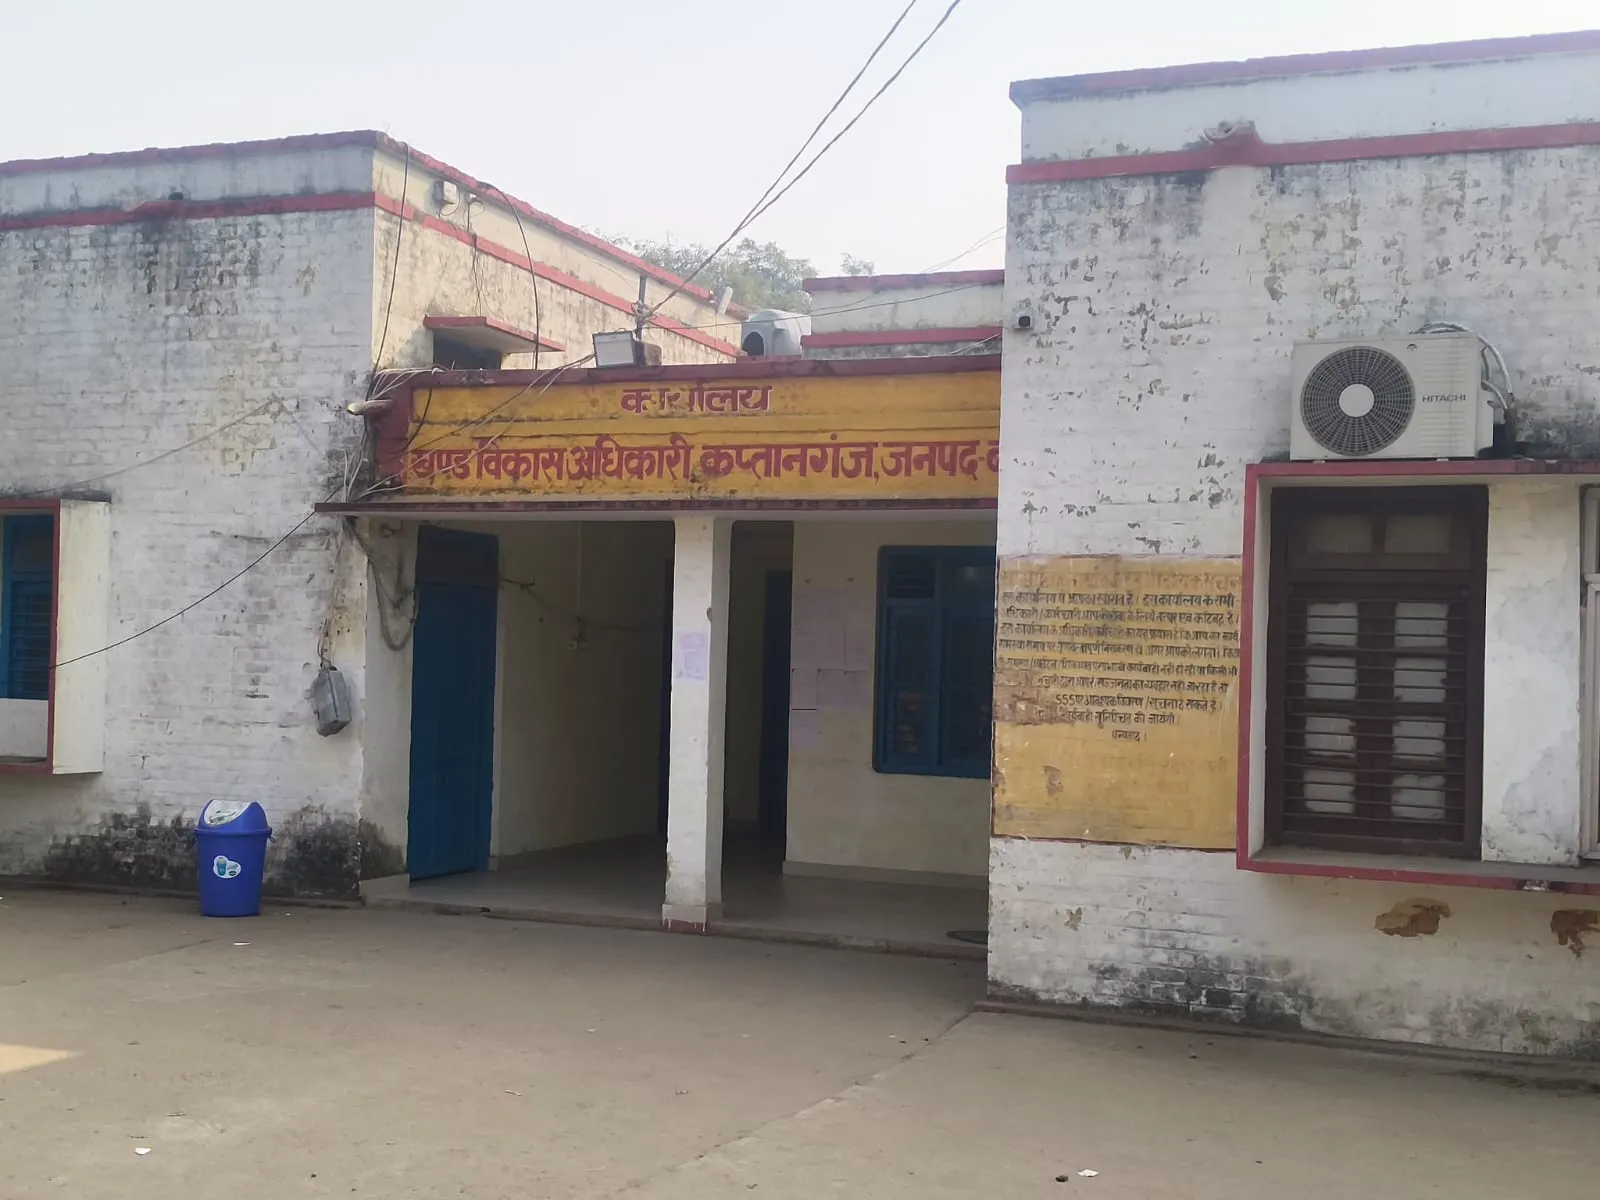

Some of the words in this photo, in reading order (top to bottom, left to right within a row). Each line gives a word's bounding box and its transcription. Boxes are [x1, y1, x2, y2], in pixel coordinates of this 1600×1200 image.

[1422, 394, 1466, 403] HITACHI
[474, 438, 567, 482] विकास
[567, 432, 695, 481] अधिकारी
